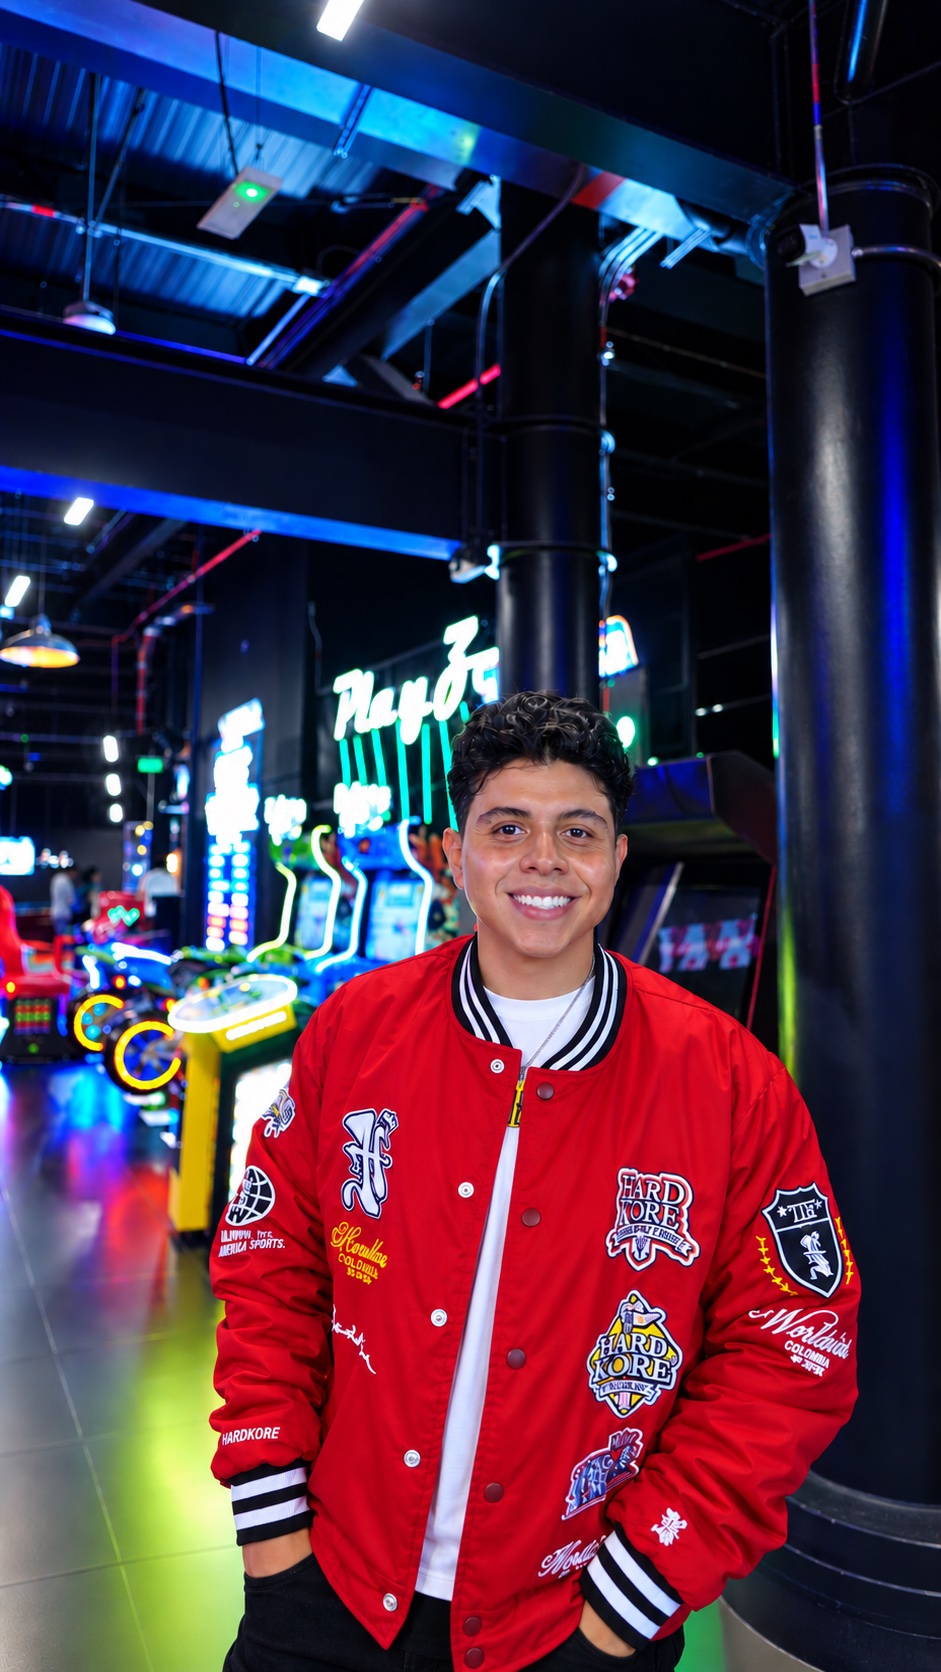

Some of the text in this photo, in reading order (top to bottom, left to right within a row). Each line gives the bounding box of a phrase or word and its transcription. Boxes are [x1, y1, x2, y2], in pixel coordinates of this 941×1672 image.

[620, 1174, 687, 1206] HARD
[618, 1199, 680, 1231] KORE
[599, 1332, 669, 1359] HARD
[592, 1352, 672, 1384] KORE
[221, 1426, 281, 1446] HARDKORE
